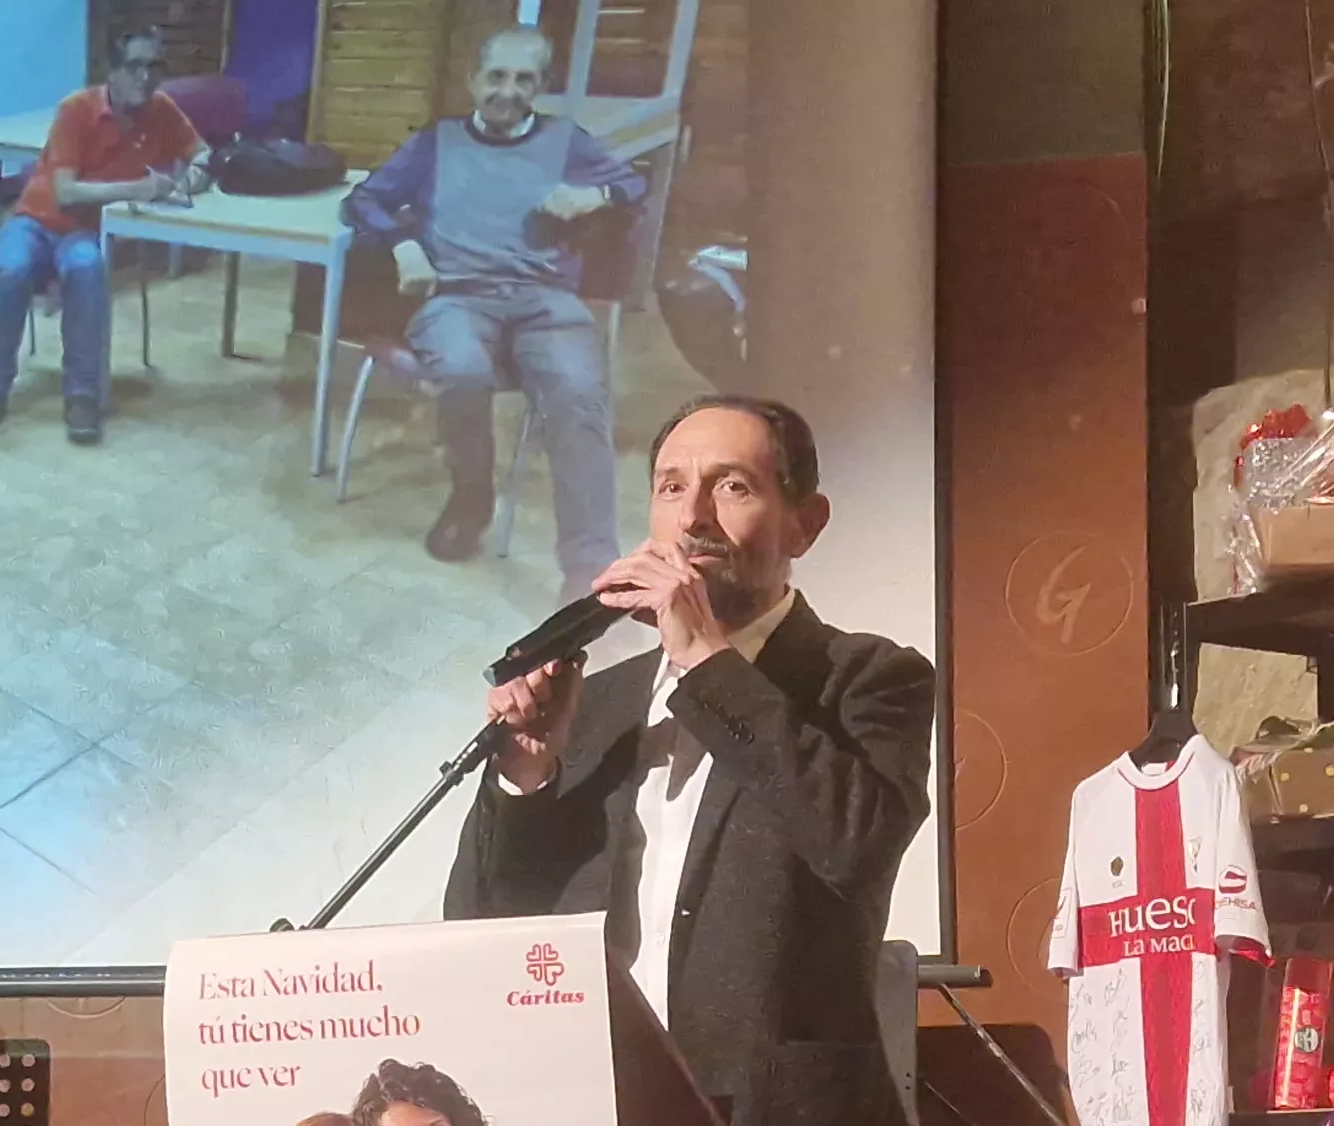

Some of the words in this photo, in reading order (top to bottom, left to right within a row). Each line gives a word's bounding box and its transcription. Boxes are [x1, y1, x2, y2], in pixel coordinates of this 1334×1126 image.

[199, 972, 256, 1000] Esta
[263, 958, 384, 997] Navidad,
[506, 989, 585, 1007] Cáritas
[198, 1015, 225, 1044] tú
[231, 1013, 314, 1043] tienes
[320, 1004, 421, 1039] mucho
[201, 1067, 252, 1098] que
[257, 1065, 301, 1087] ver
